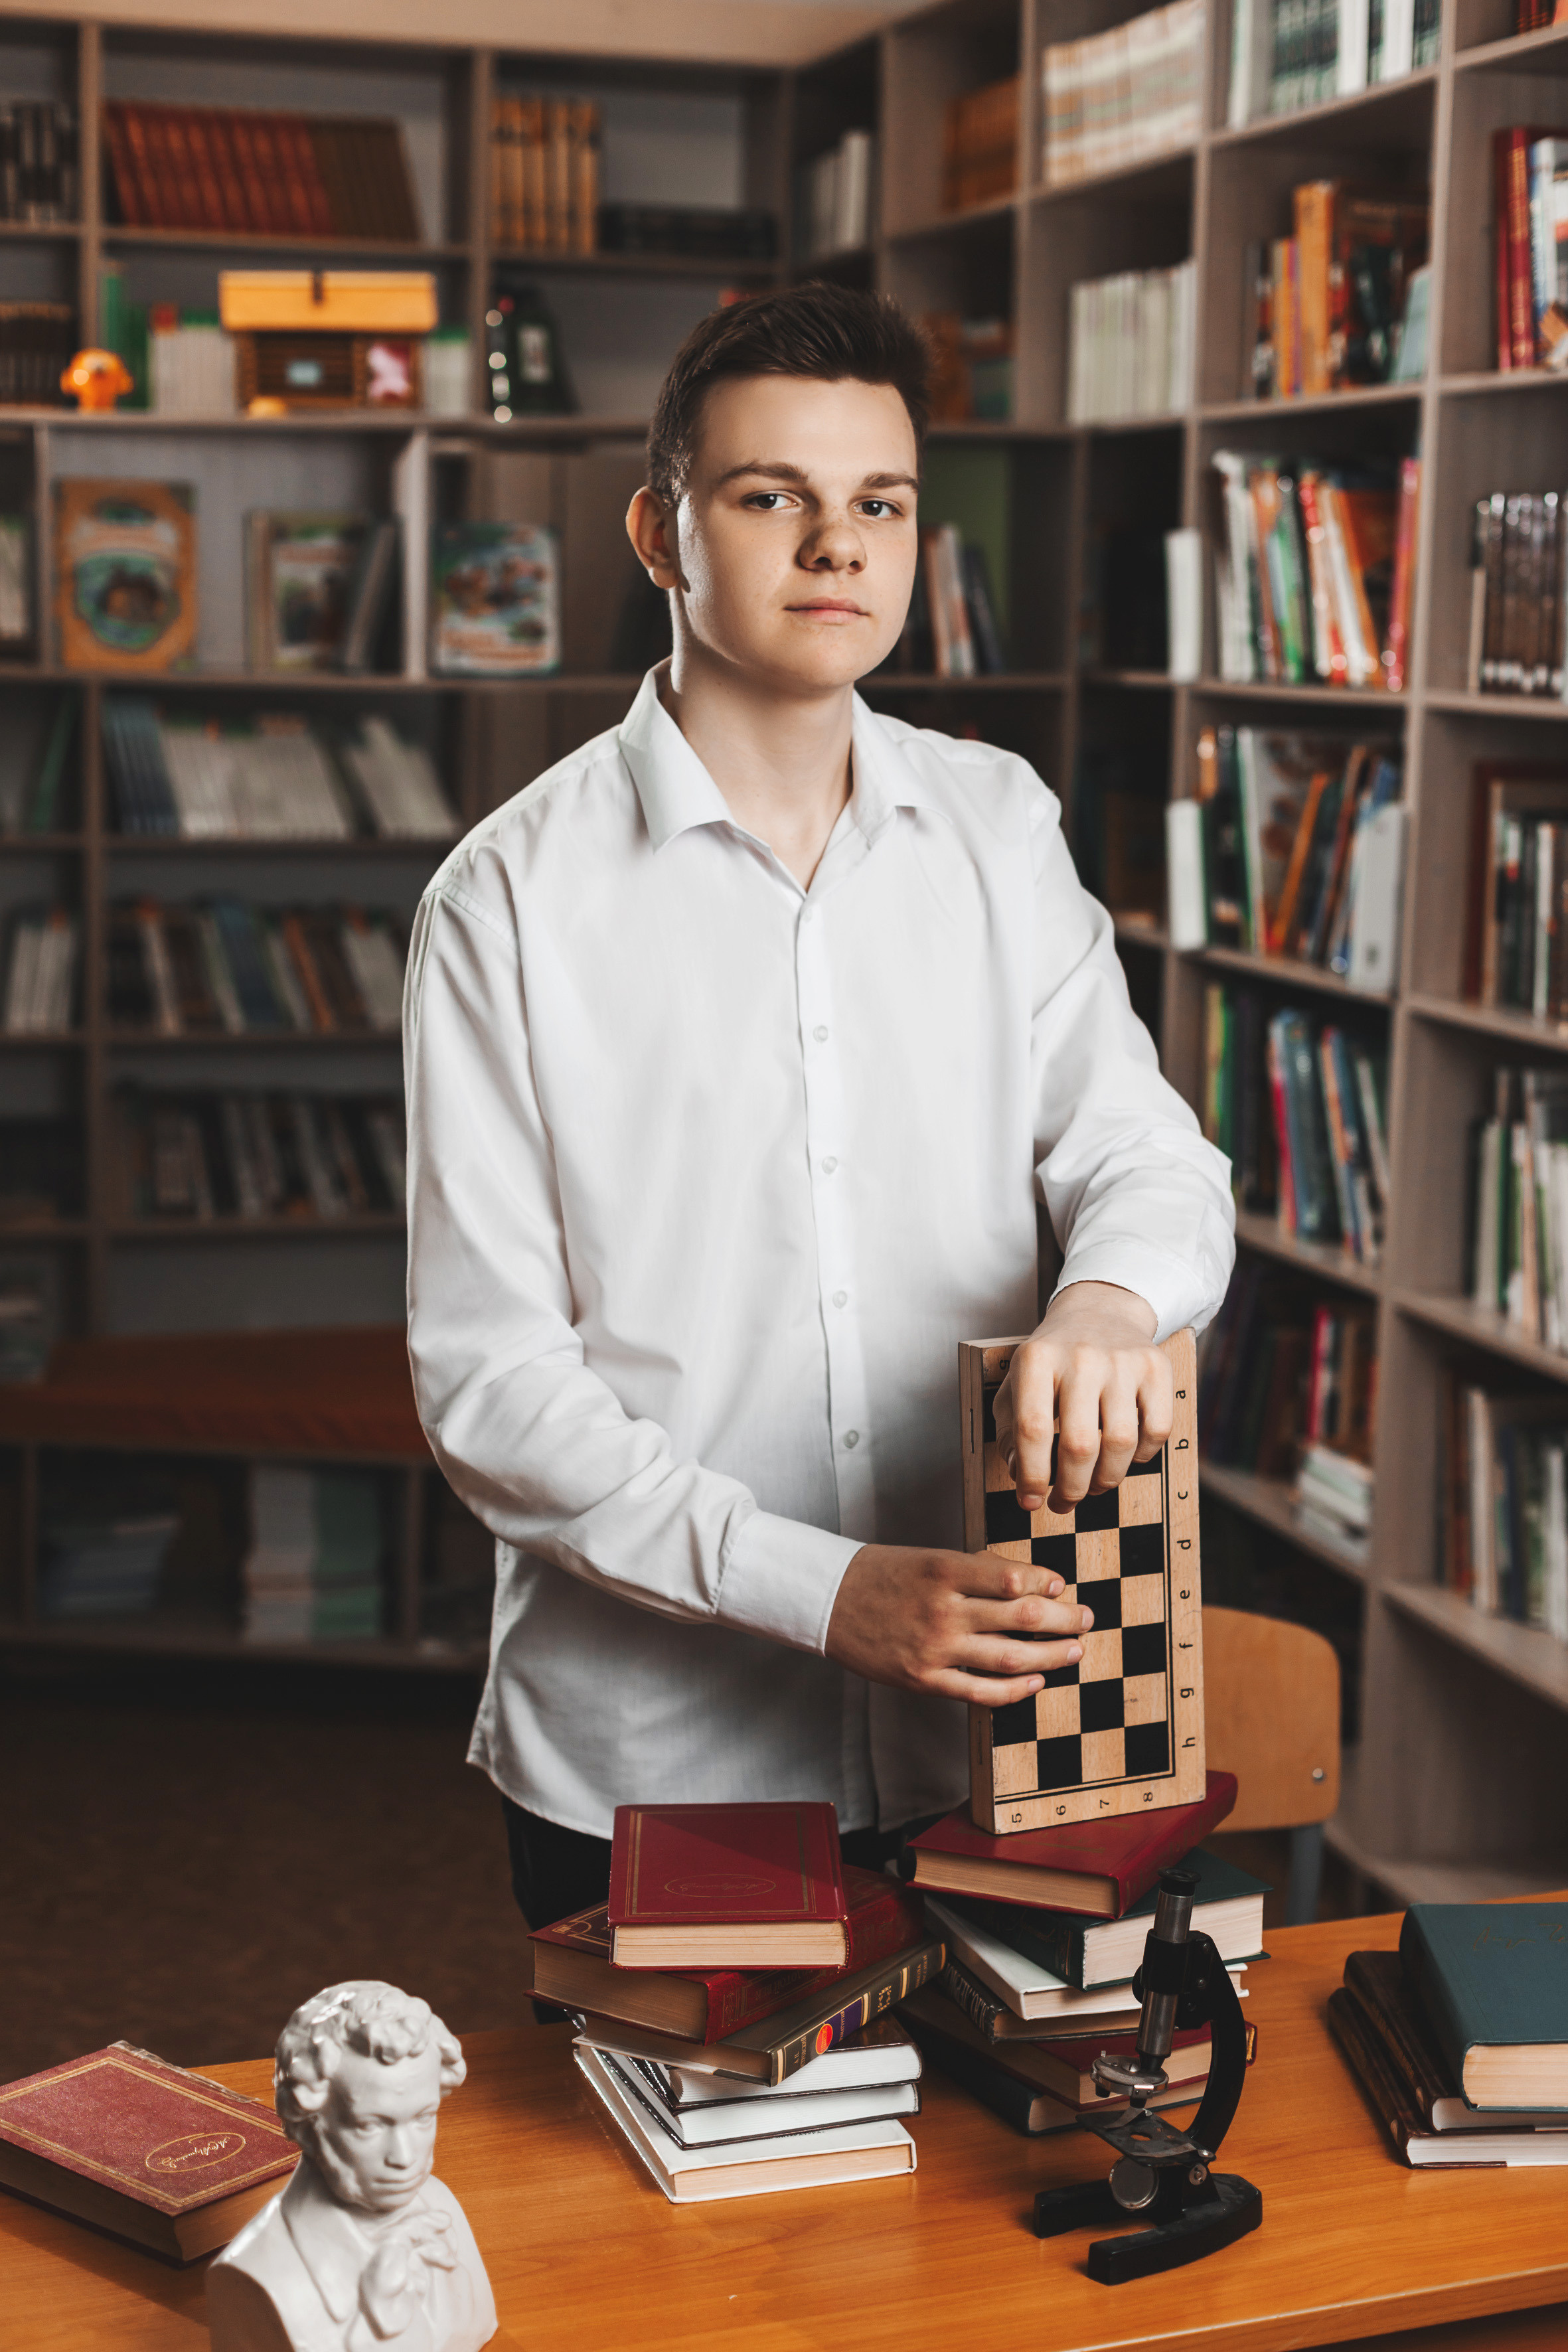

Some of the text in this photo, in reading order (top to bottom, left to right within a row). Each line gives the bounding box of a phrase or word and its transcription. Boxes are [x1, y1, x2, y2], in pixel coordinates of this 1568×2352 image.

[1175, 1389, 1186, 1399] a
[1174, 1439, 1189, 1450] b
[1177, 1491, 1188, 1500] c
[1176, 1539, 1192, 1550] d
[1180, 1589, 1190, 1600] e
[1180, 1687, 1194, 1699] g
[1182, 1737, 1196, 1748] h
[1012, 1792, 1153, 1824] 5 6 7 8
